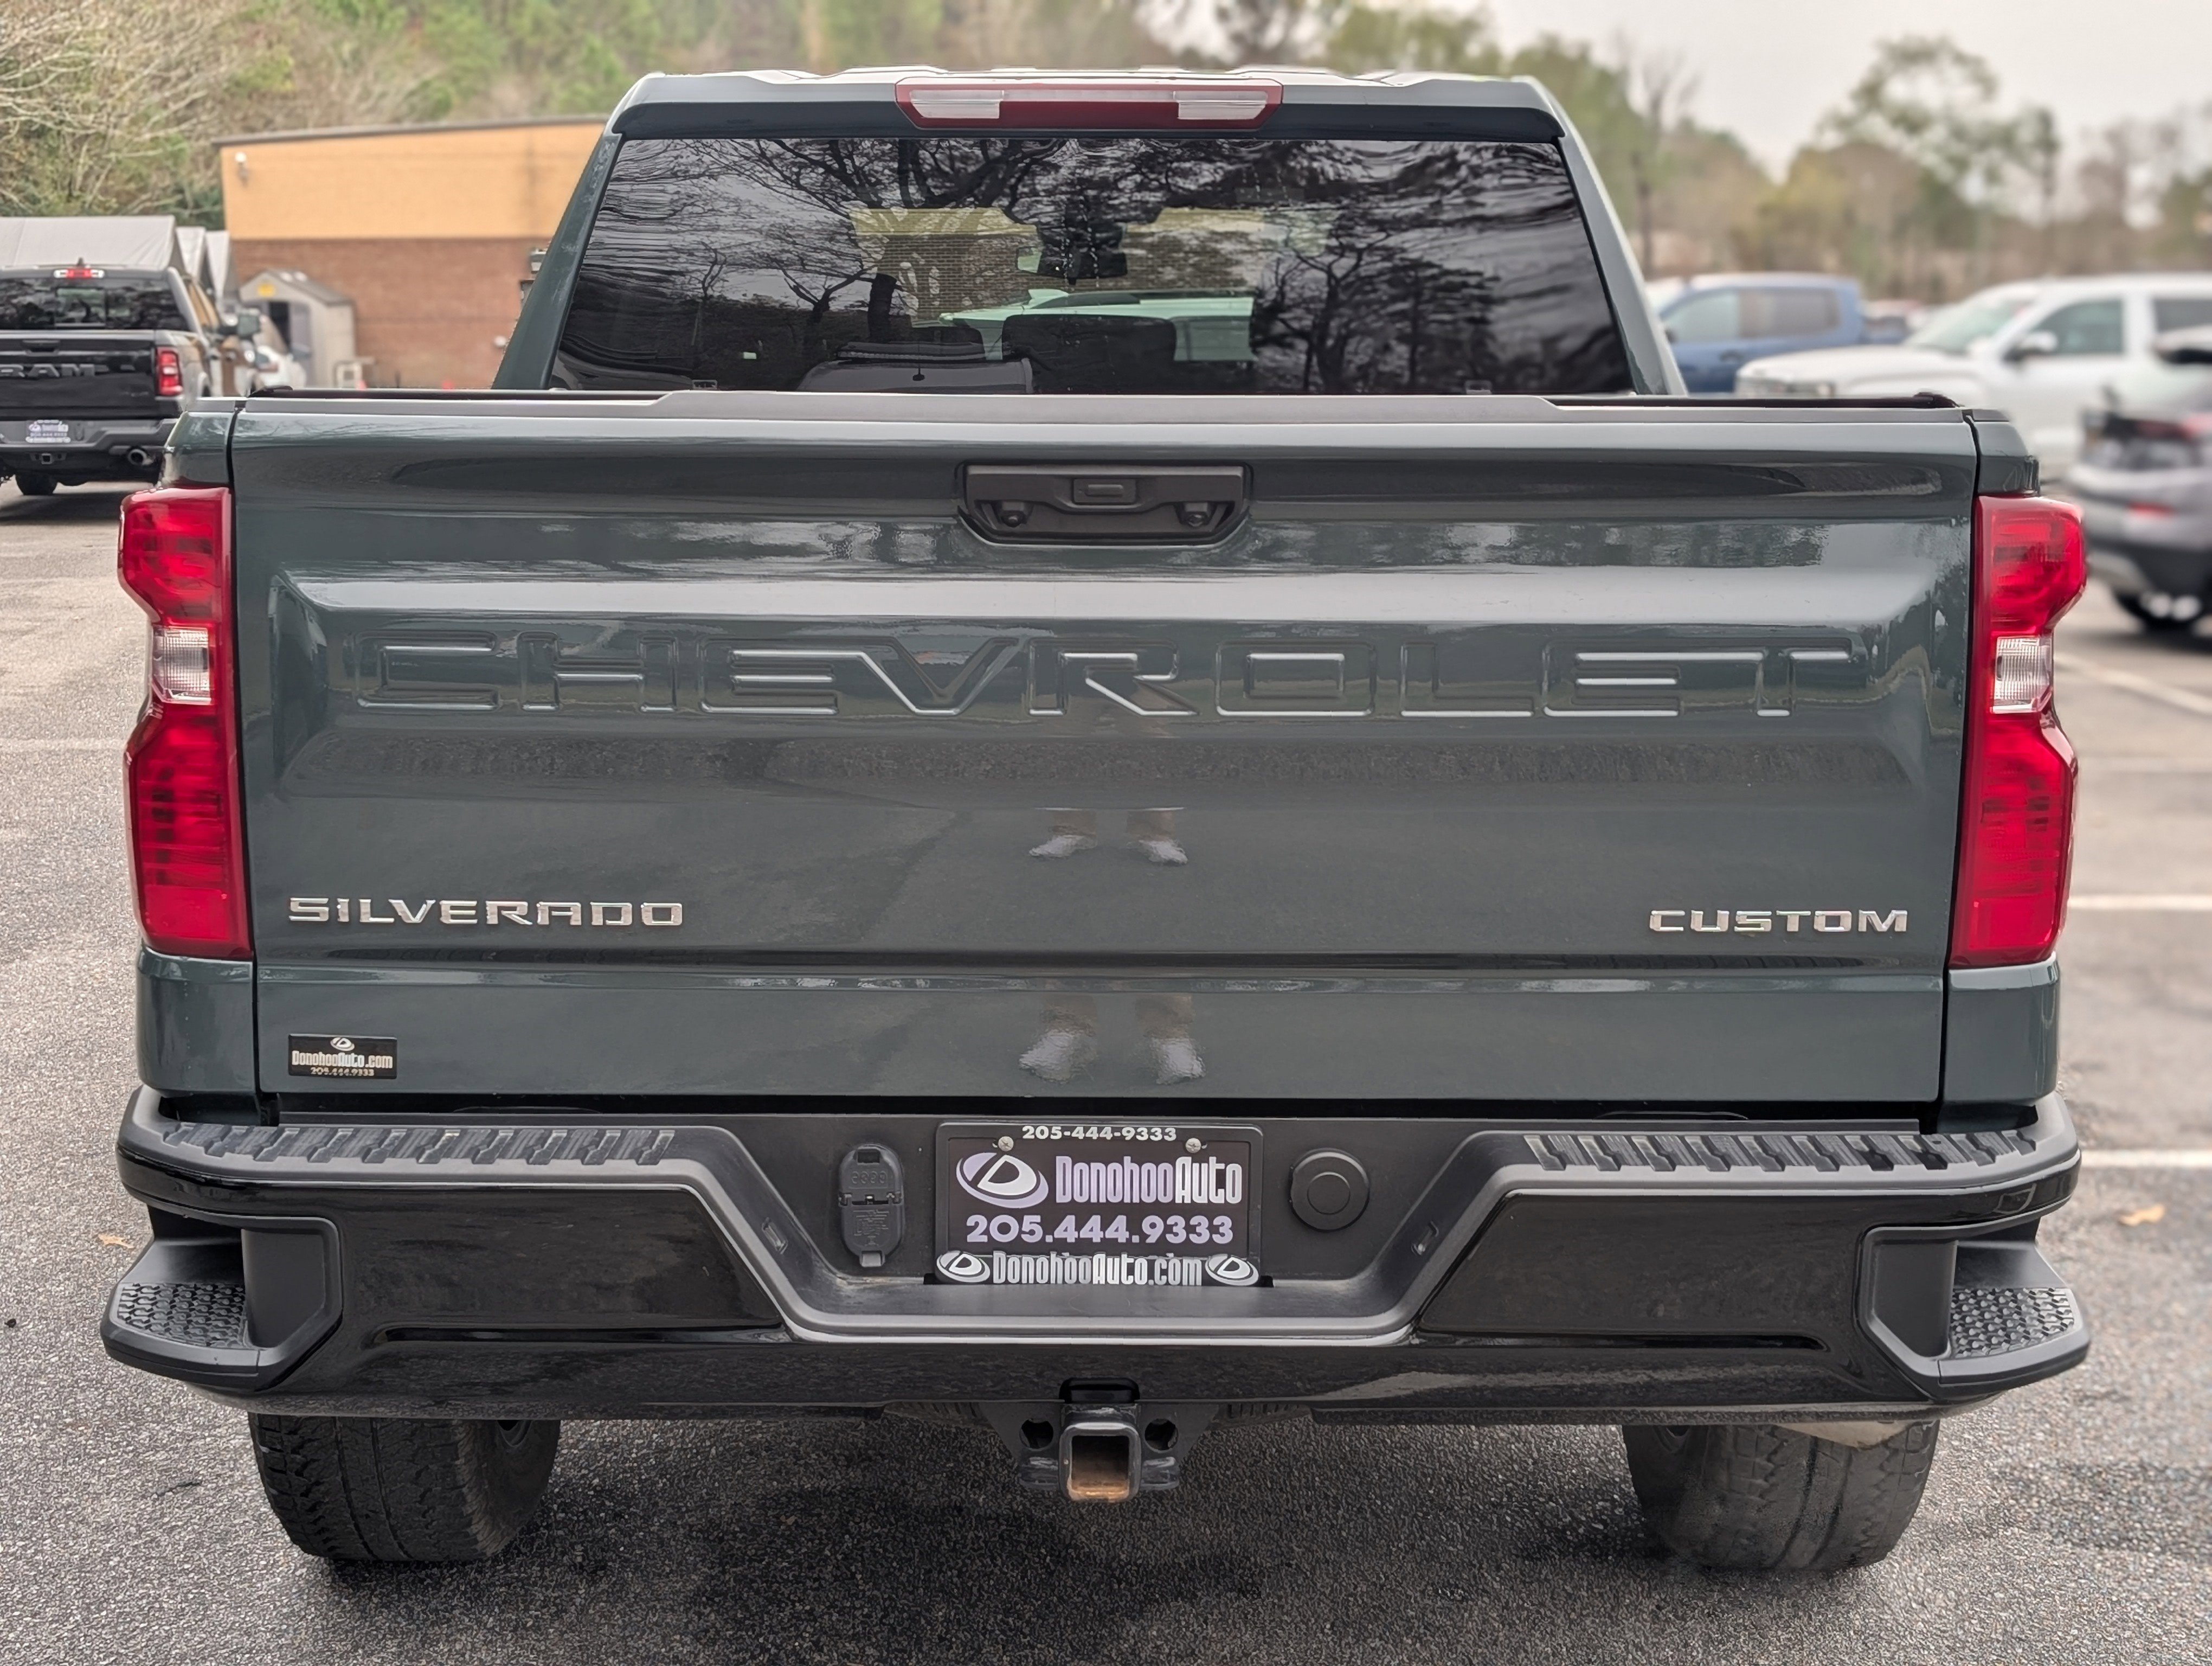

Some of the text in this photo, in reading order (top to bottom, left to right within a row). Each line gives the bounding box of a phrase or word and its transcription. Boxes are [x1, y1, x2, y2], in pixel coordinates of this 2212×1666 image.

[353, 631, 1861, 716] CHEVROLET
[289, 898, 683, 925] SILVERADO
[1649, 909, 1908, 932] CUSTOM
[292, 1050, 393, 1068] DonohooAuto.com
[310, 1067, 375, 1077] 205.444.9333
[1022, 1125, 1177, 1141] 205-444-9333
[1056, 1156, 1242, 1204] DonohooAuto
[966, 1215, 1233, 1244] 205.444.9333
[992, 1251, 1202, 1286] DonohooAuto.com
